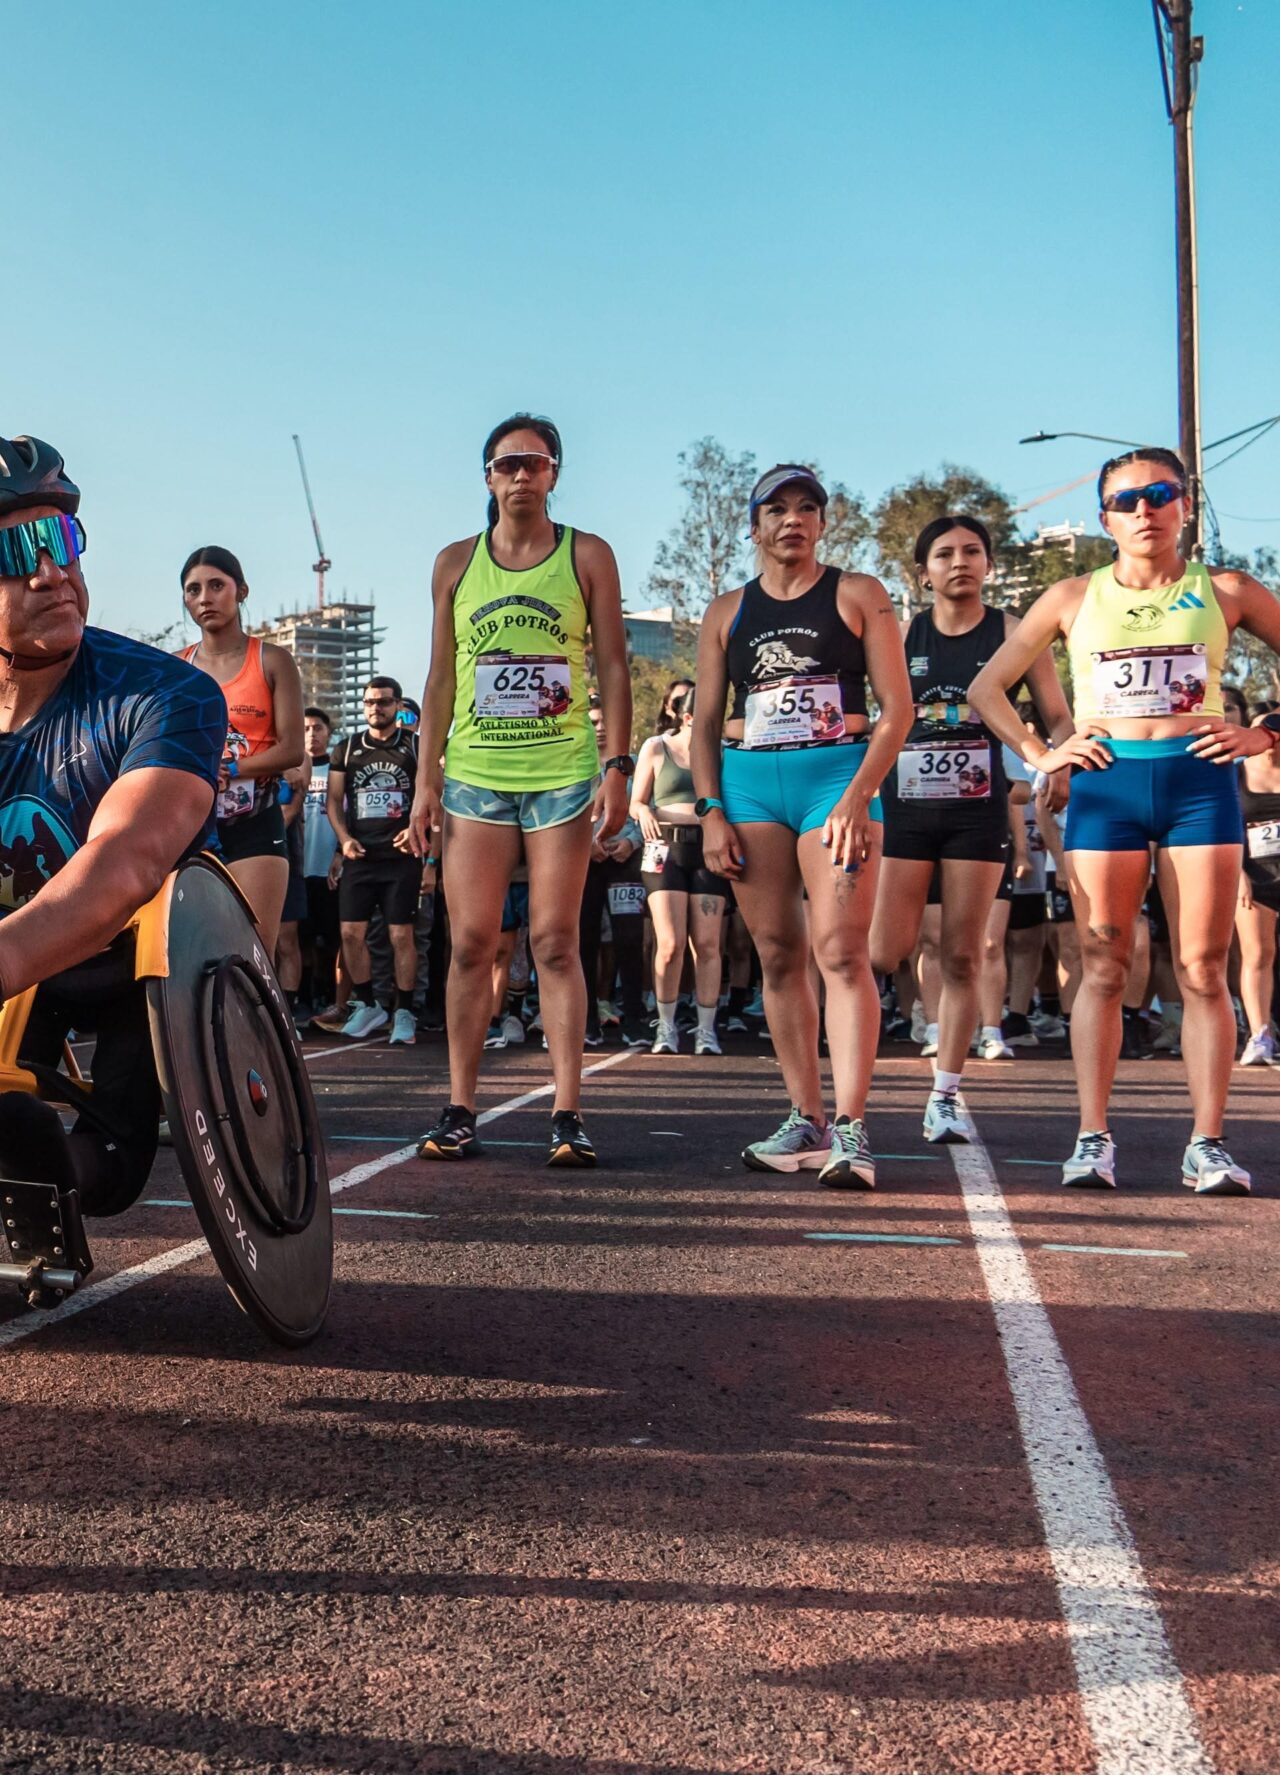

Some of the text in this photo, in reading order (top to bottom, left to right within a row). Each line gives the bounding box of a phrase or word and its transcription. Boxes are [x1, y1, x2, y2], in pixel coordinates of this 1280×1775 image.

[467, 614, 569, 654] CLUB POTROS
[749, 627, 819, 647] CLUB POTROS
[493, 667, 545, 691] 625
[1113, 659, 1174, 689] 311
[762, 688, 815, 718] 355
[1120, 689, 1159, 698] CARRERA
[480, 719, 538, 730] ATLETISMO
[767, 717, 802, 726] CARRERA
[480, 728, 565, 741] INTERNATIONAL
[918, 752, 970, 775] 369
[363, 761, 411, 789] UNLIMITED
[365, 792, 391, 806] 059
[613, 887, 643, 901] 1082
[195, 1109, 257, 1271] EXCEED
